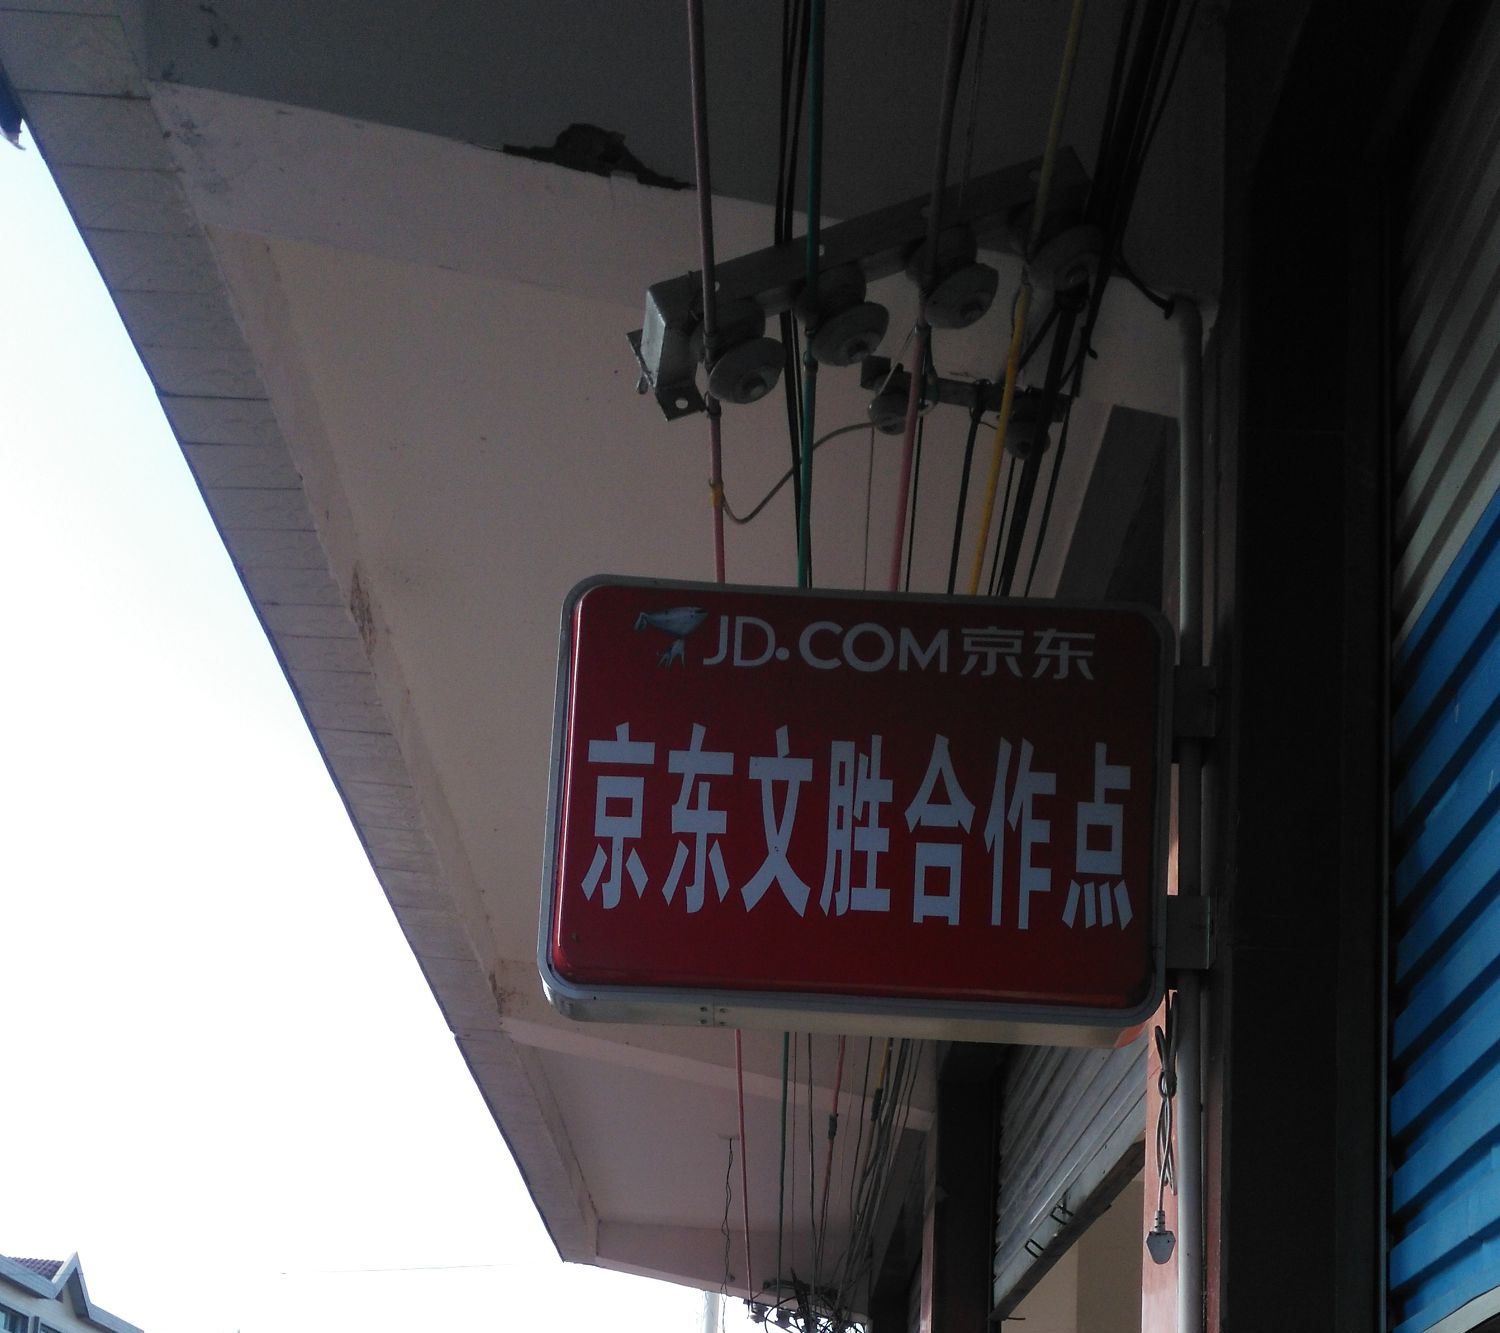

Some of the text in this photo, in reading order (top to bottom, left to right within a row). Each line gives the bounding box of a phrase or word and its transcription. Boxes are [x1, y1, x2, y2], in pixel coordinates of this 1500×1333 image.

[580, 720, 1134, 932] 京东文胜合作点
